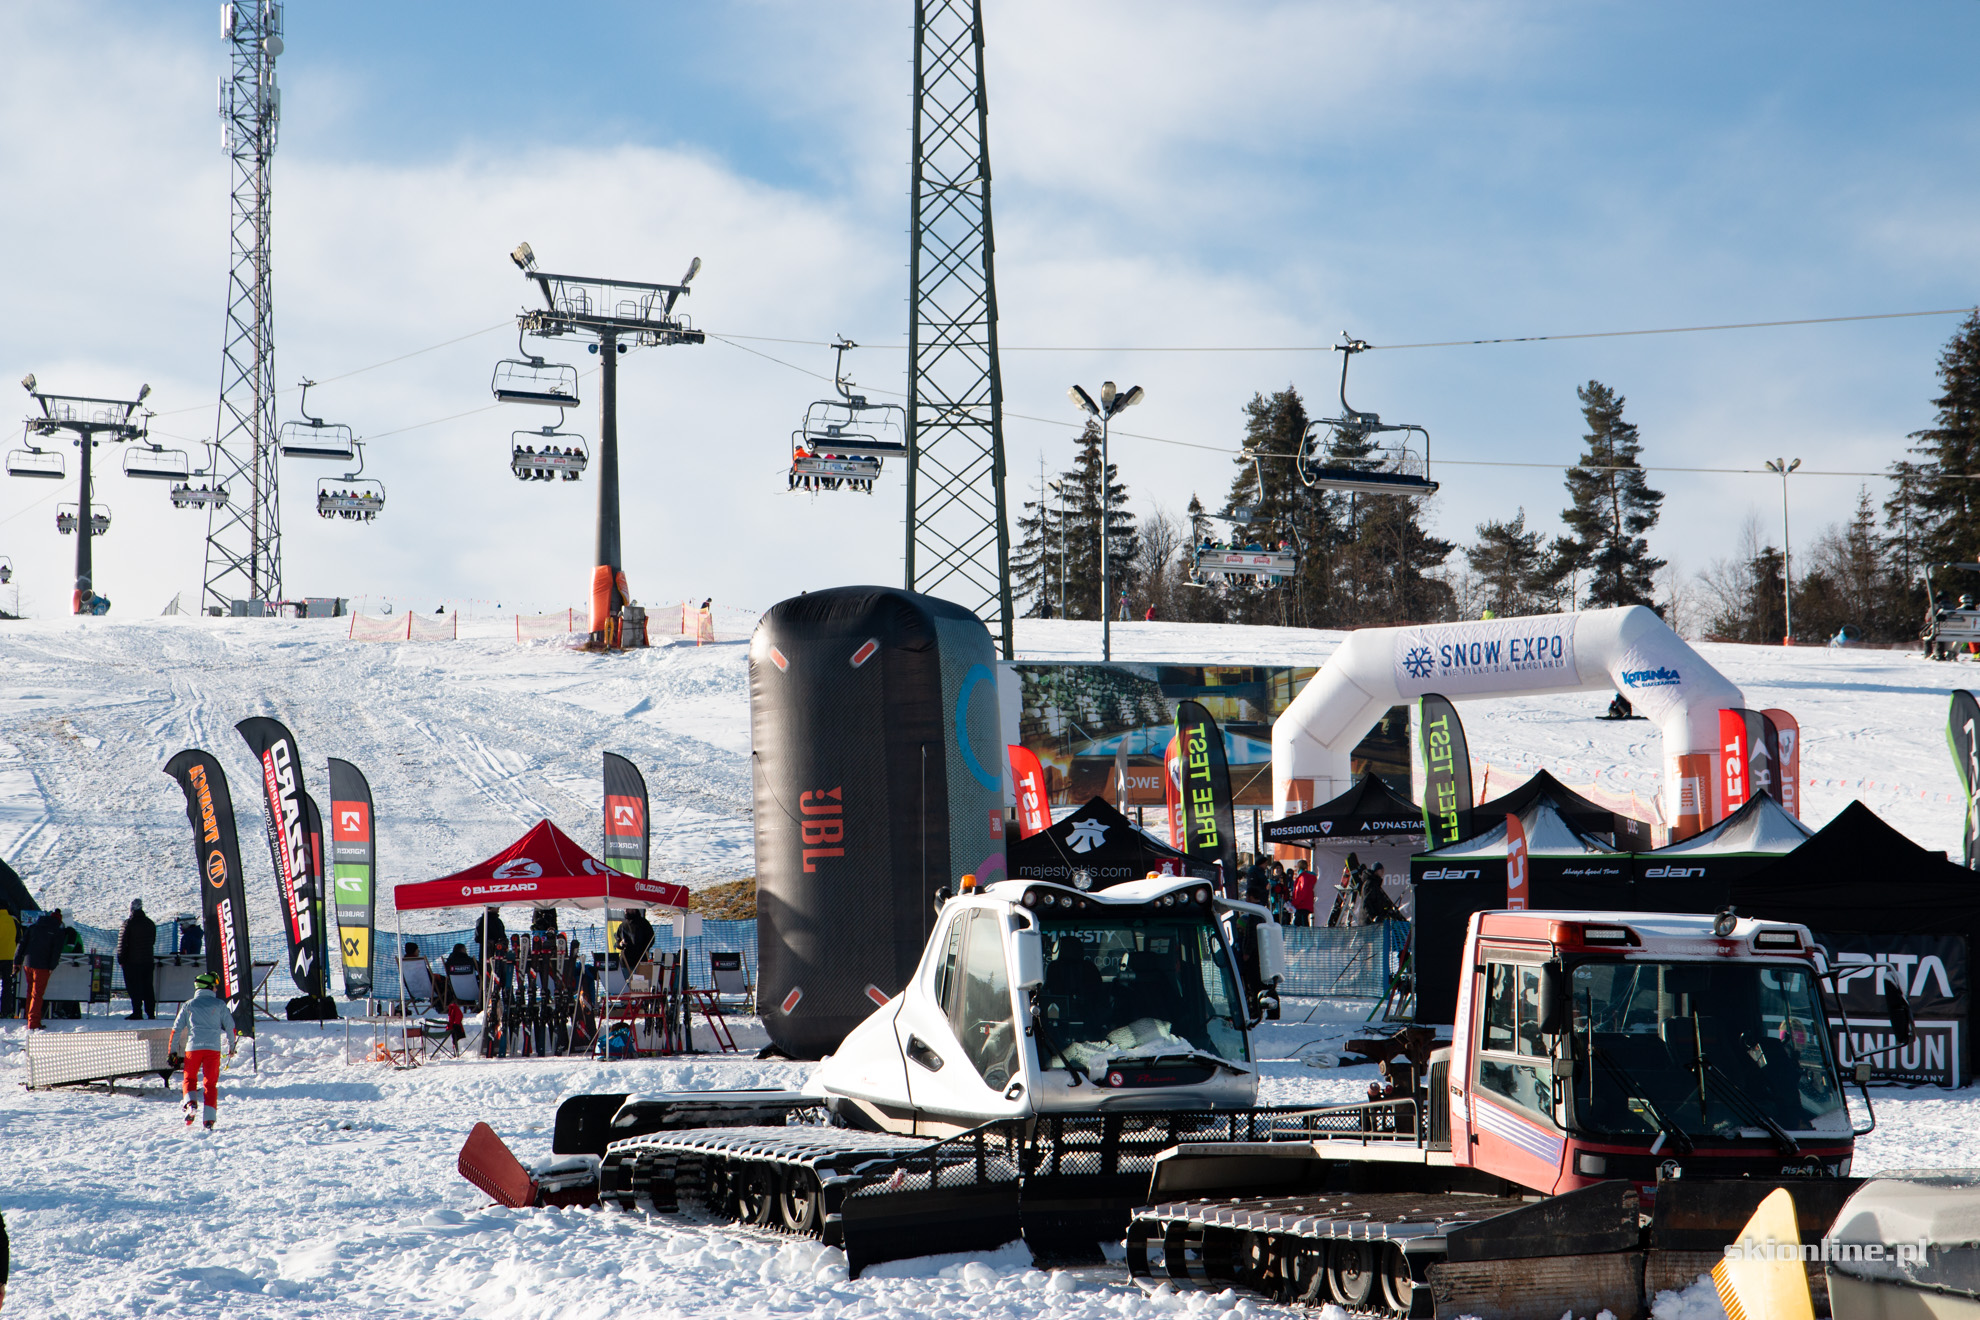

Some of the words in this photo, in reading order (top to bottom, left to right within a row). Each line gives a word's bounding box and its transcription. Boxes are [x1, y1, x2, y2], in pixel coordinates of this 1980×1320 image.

[1441, 640, 1501, 668] SNOW
[1510, 634, 1563, 662] EXPO
[1443, 668, 1457, 677] NIE
[1463, 666, 1490, 675] TYLKO
[1494, 664, 1510, 672] DLA
[1114, 776, 1160, 789] OWE
[1270, 824, 1320, 837] ROSSIGNOL
[1372, 819, 1426, 831] DYNASTAR
[1019, 863, 1132, 881] majestyskis.com
[1422, 867, 1480, 880] elan
[1585, 867, 1603, 876] Good
[1645, 865, 1706, 878] elan
[472, 883, 538, 895] BLIZZARD
[639, 883, 666, 895] BLIZZARD
[1838, 1031, 1945, 1070] UNION
